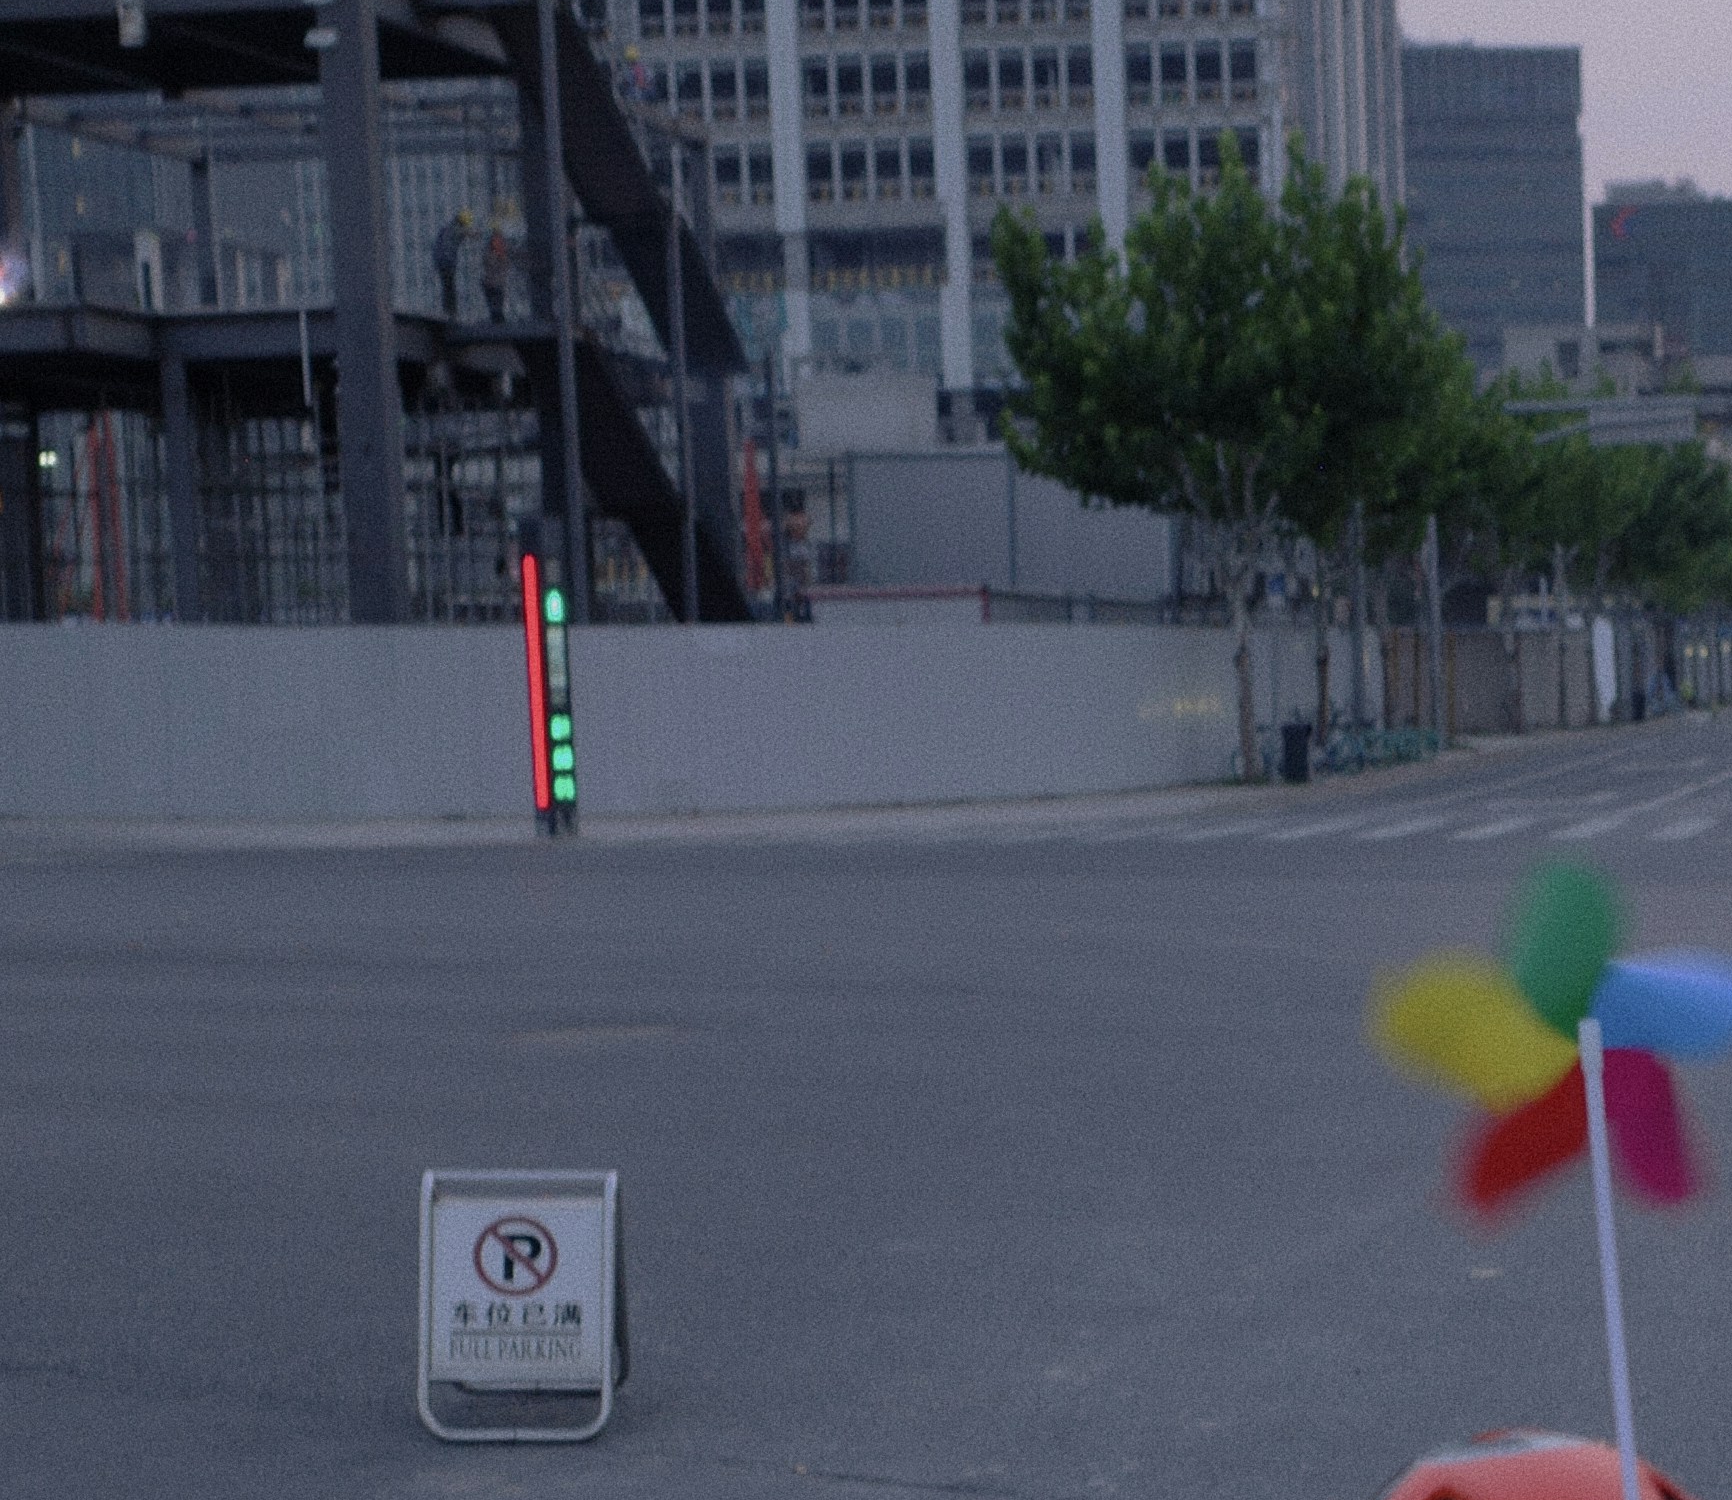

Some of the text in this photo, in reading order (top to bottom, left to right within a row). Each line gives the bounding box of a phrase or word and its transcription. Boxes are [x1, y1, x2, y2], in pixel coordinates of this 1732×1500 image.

[502, 1235, 542, 1281] P
[450, 1337, 582, 1361] FULL PARKING
